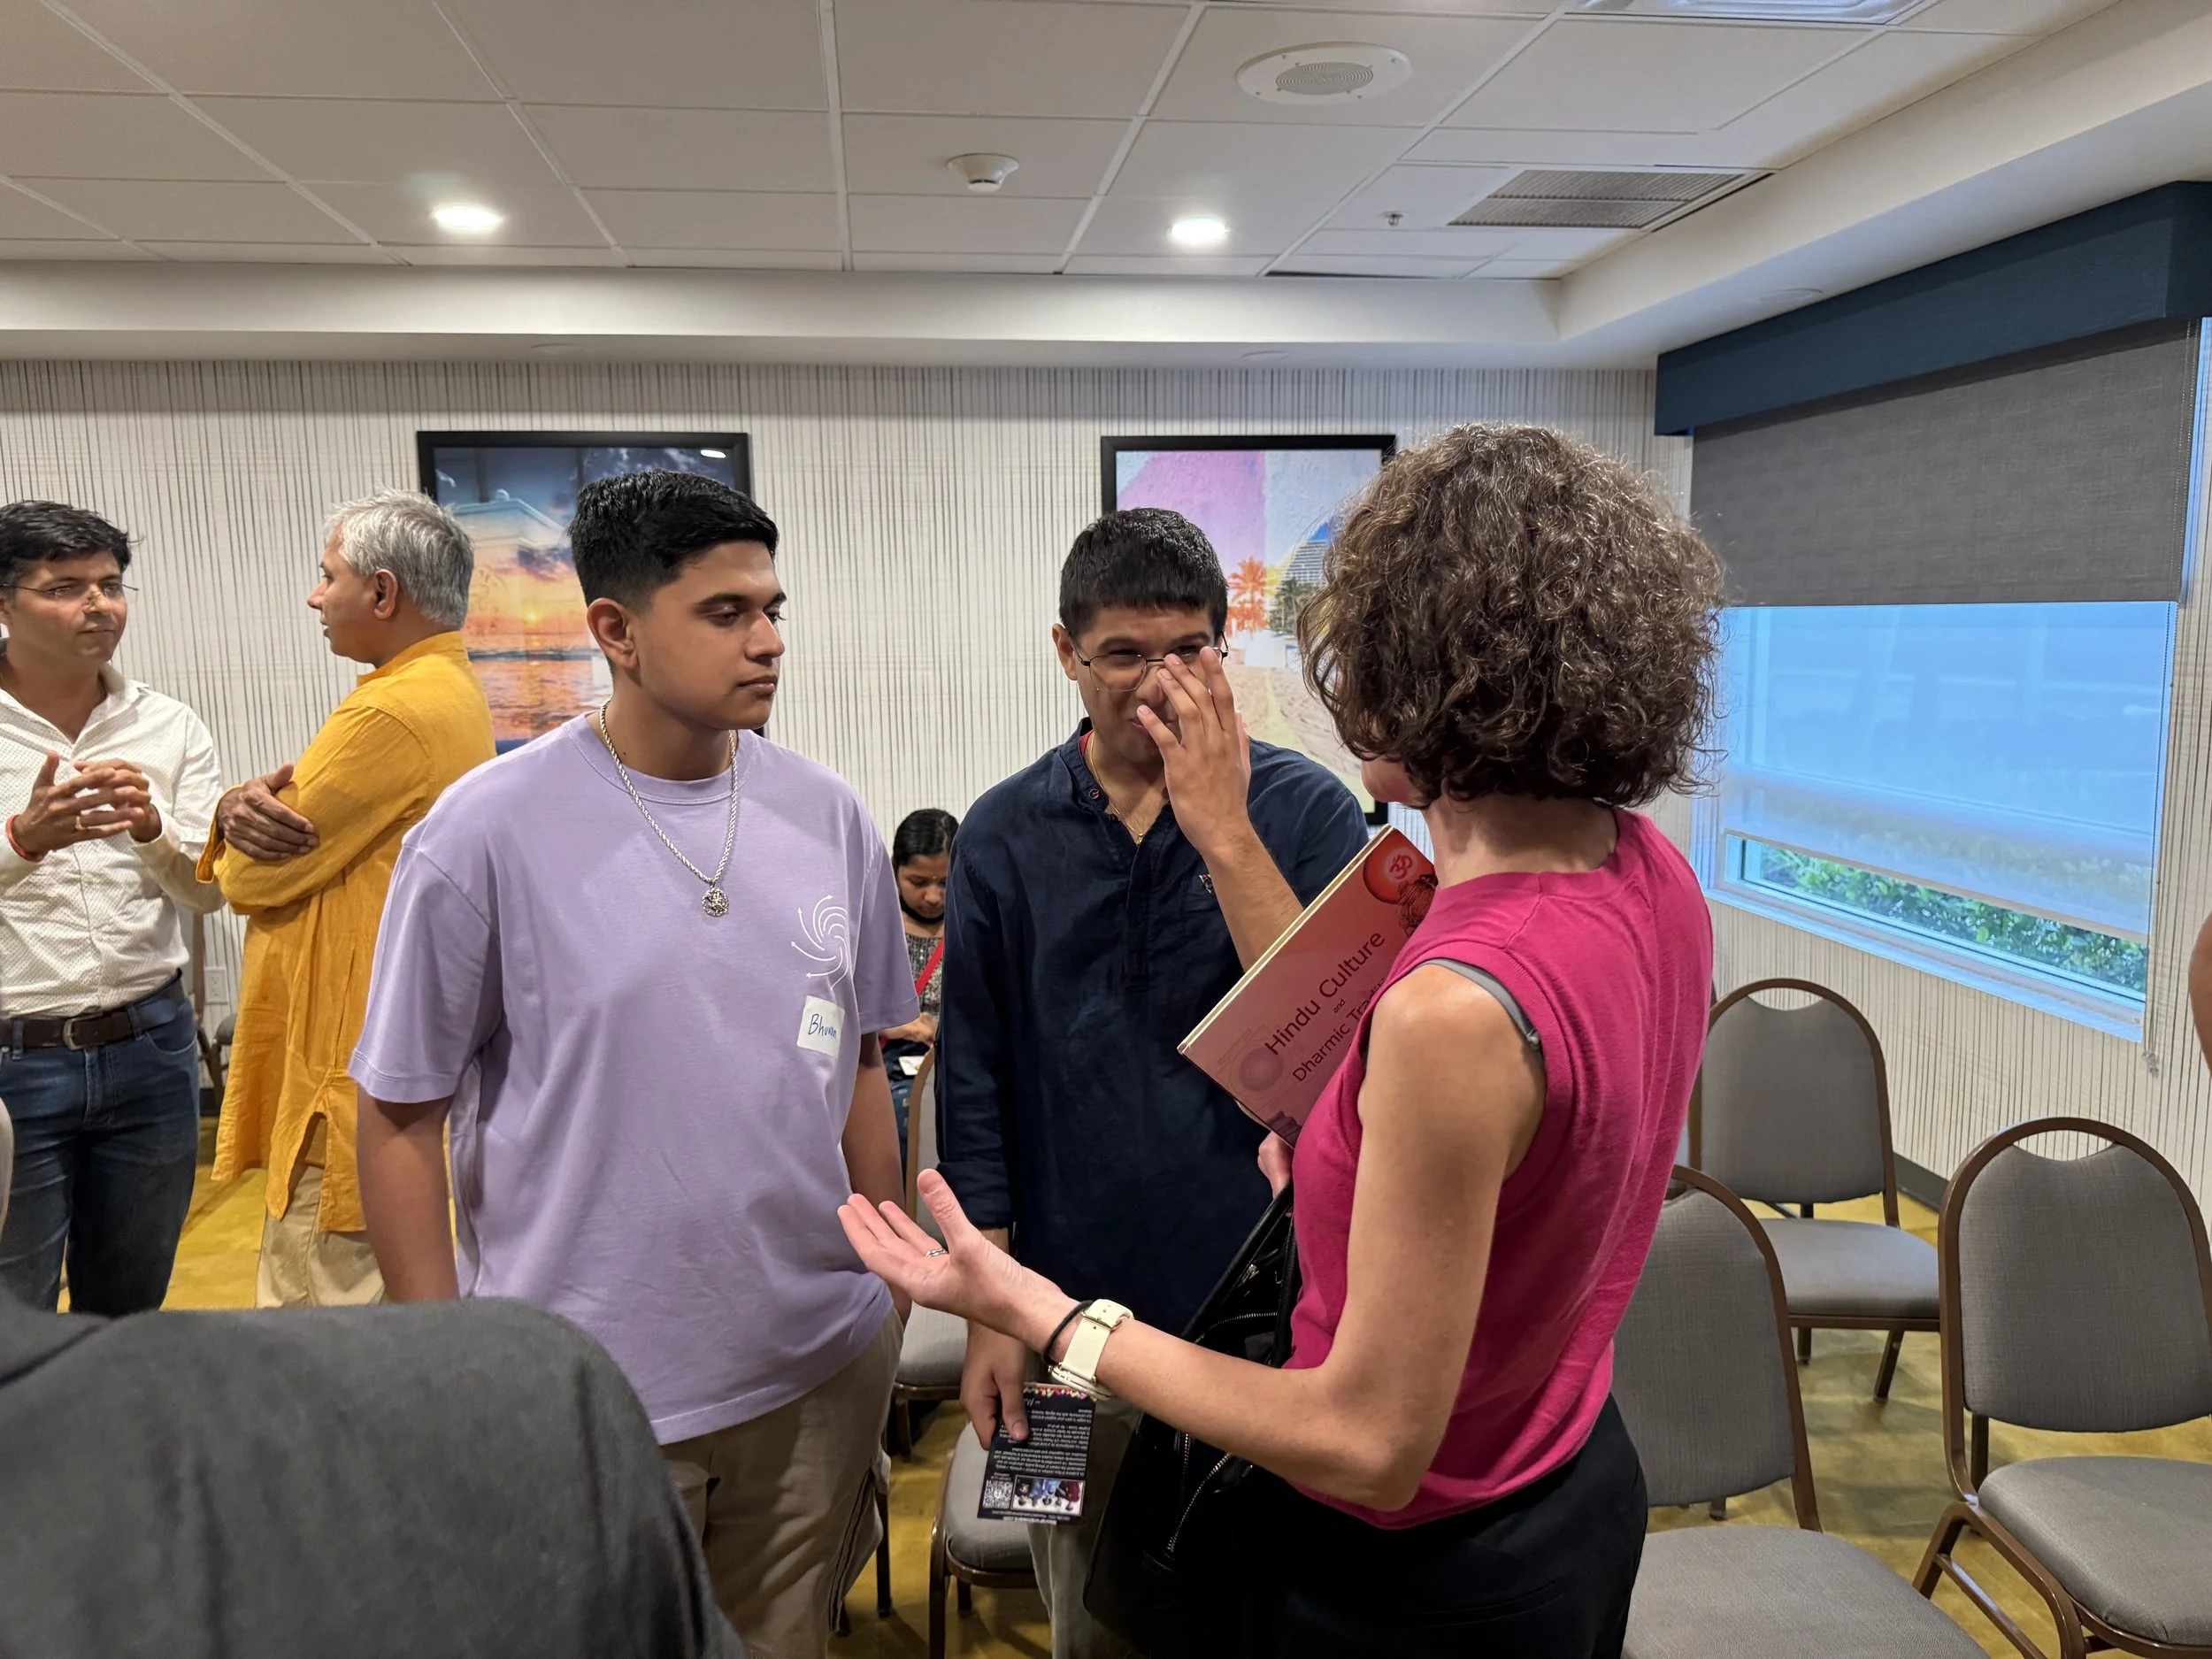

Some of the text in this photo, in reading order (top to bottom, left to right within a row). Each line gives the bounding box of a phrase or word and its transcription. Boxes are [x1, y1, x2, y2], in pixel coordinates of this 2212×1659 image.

[1264, 932, 1385, 1056] Hindu Culture
[1333, 998, 1346, 1013] and
[1292, 1023, 1351, 1081] Dharmic
